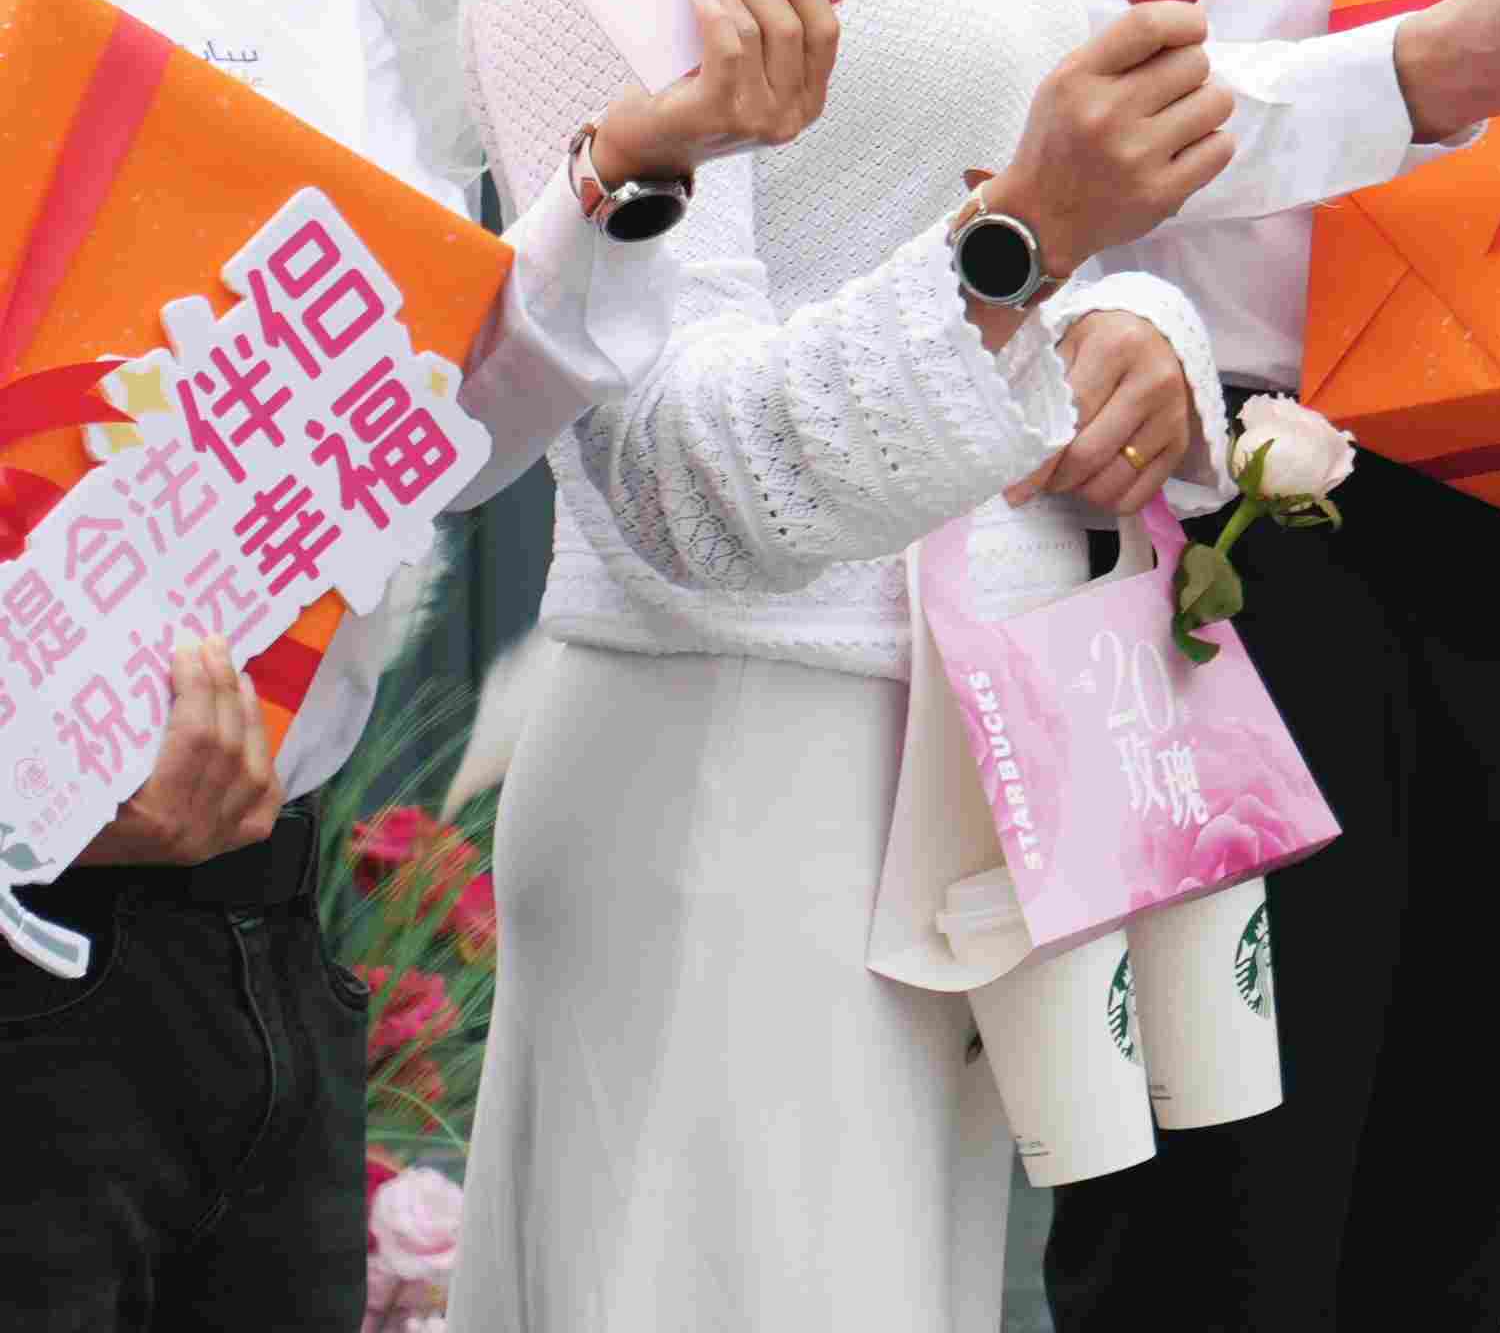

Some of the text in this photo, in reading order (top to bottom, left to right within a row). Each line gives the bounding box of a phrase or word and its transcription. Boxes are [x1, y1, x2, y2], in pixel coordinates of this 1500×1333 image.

[0, 219, 388, 729] 提合法伴侣
[968, 671, 1044, 870] STARBUCKS
